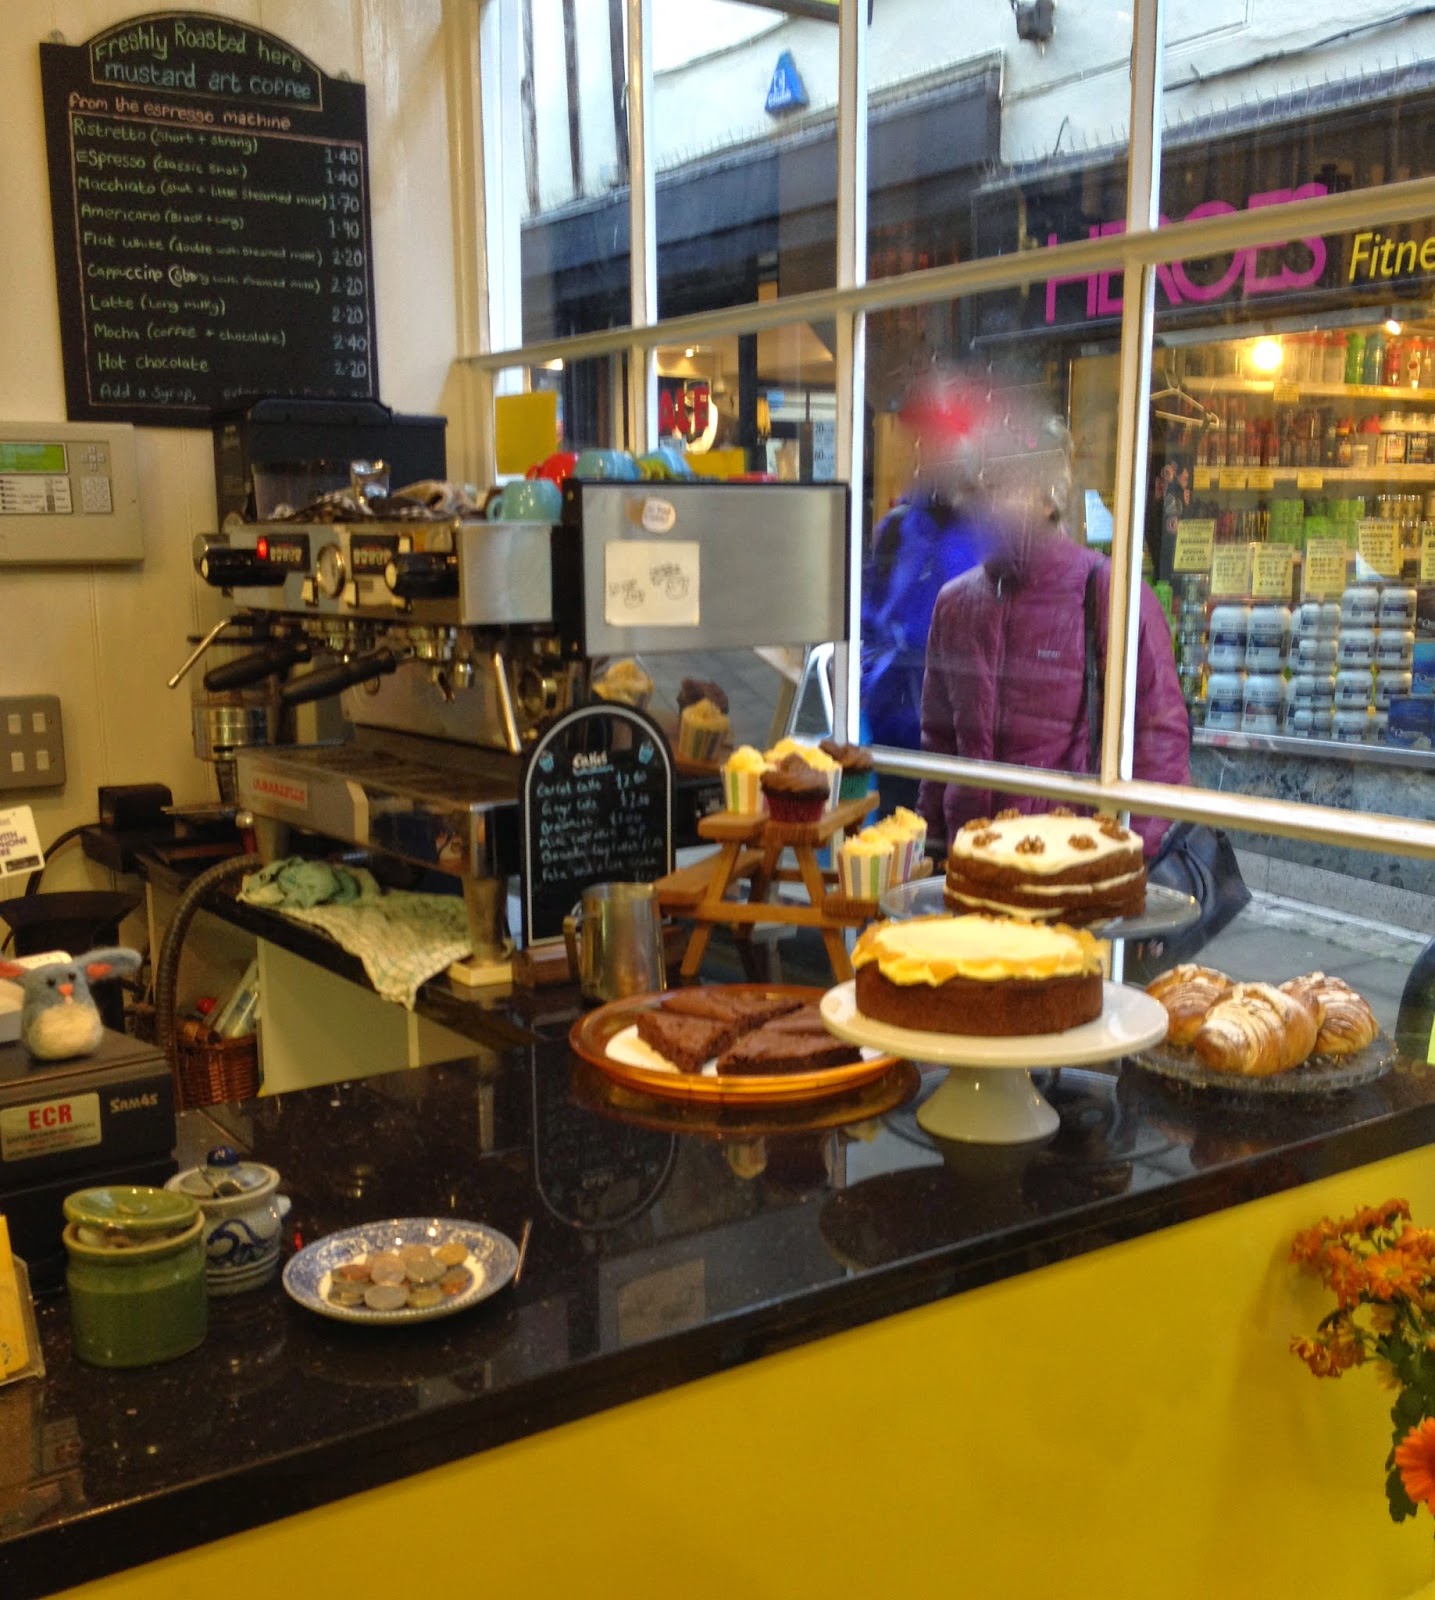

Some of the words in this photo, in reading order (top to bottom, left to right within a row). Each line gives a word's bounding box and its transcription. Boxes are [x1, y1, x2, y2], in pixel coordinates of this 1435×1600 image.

[95, 24, 168, 61] Freshly
[174, 21, 247, 54] Roasted
[257, 39, 302, 73] here
[104, 62, 197, 89] mustard
[208, 72, 243, 94] art
[249, 76, 312, 100] coffee
[69, 92, 108, 110] from
[115, 96, 140, 113] the
[143, 101, 215, 124] espresso
[223, 110, 291, 131] machine
[74, 117, 147, 142] Ristretto
[77, 176, 156, 195] Macchiato
[81, 202, 161, 222] Americano
[84, 231, 116, 247] Flat
[90, 294, 134, 311] Latte
[94, 323, 140, 340] Mocha
[98, 352, 127, 371] Hot
[100, 383, 131, 399] Add
[28, 1103, 73, 1131] ECR
